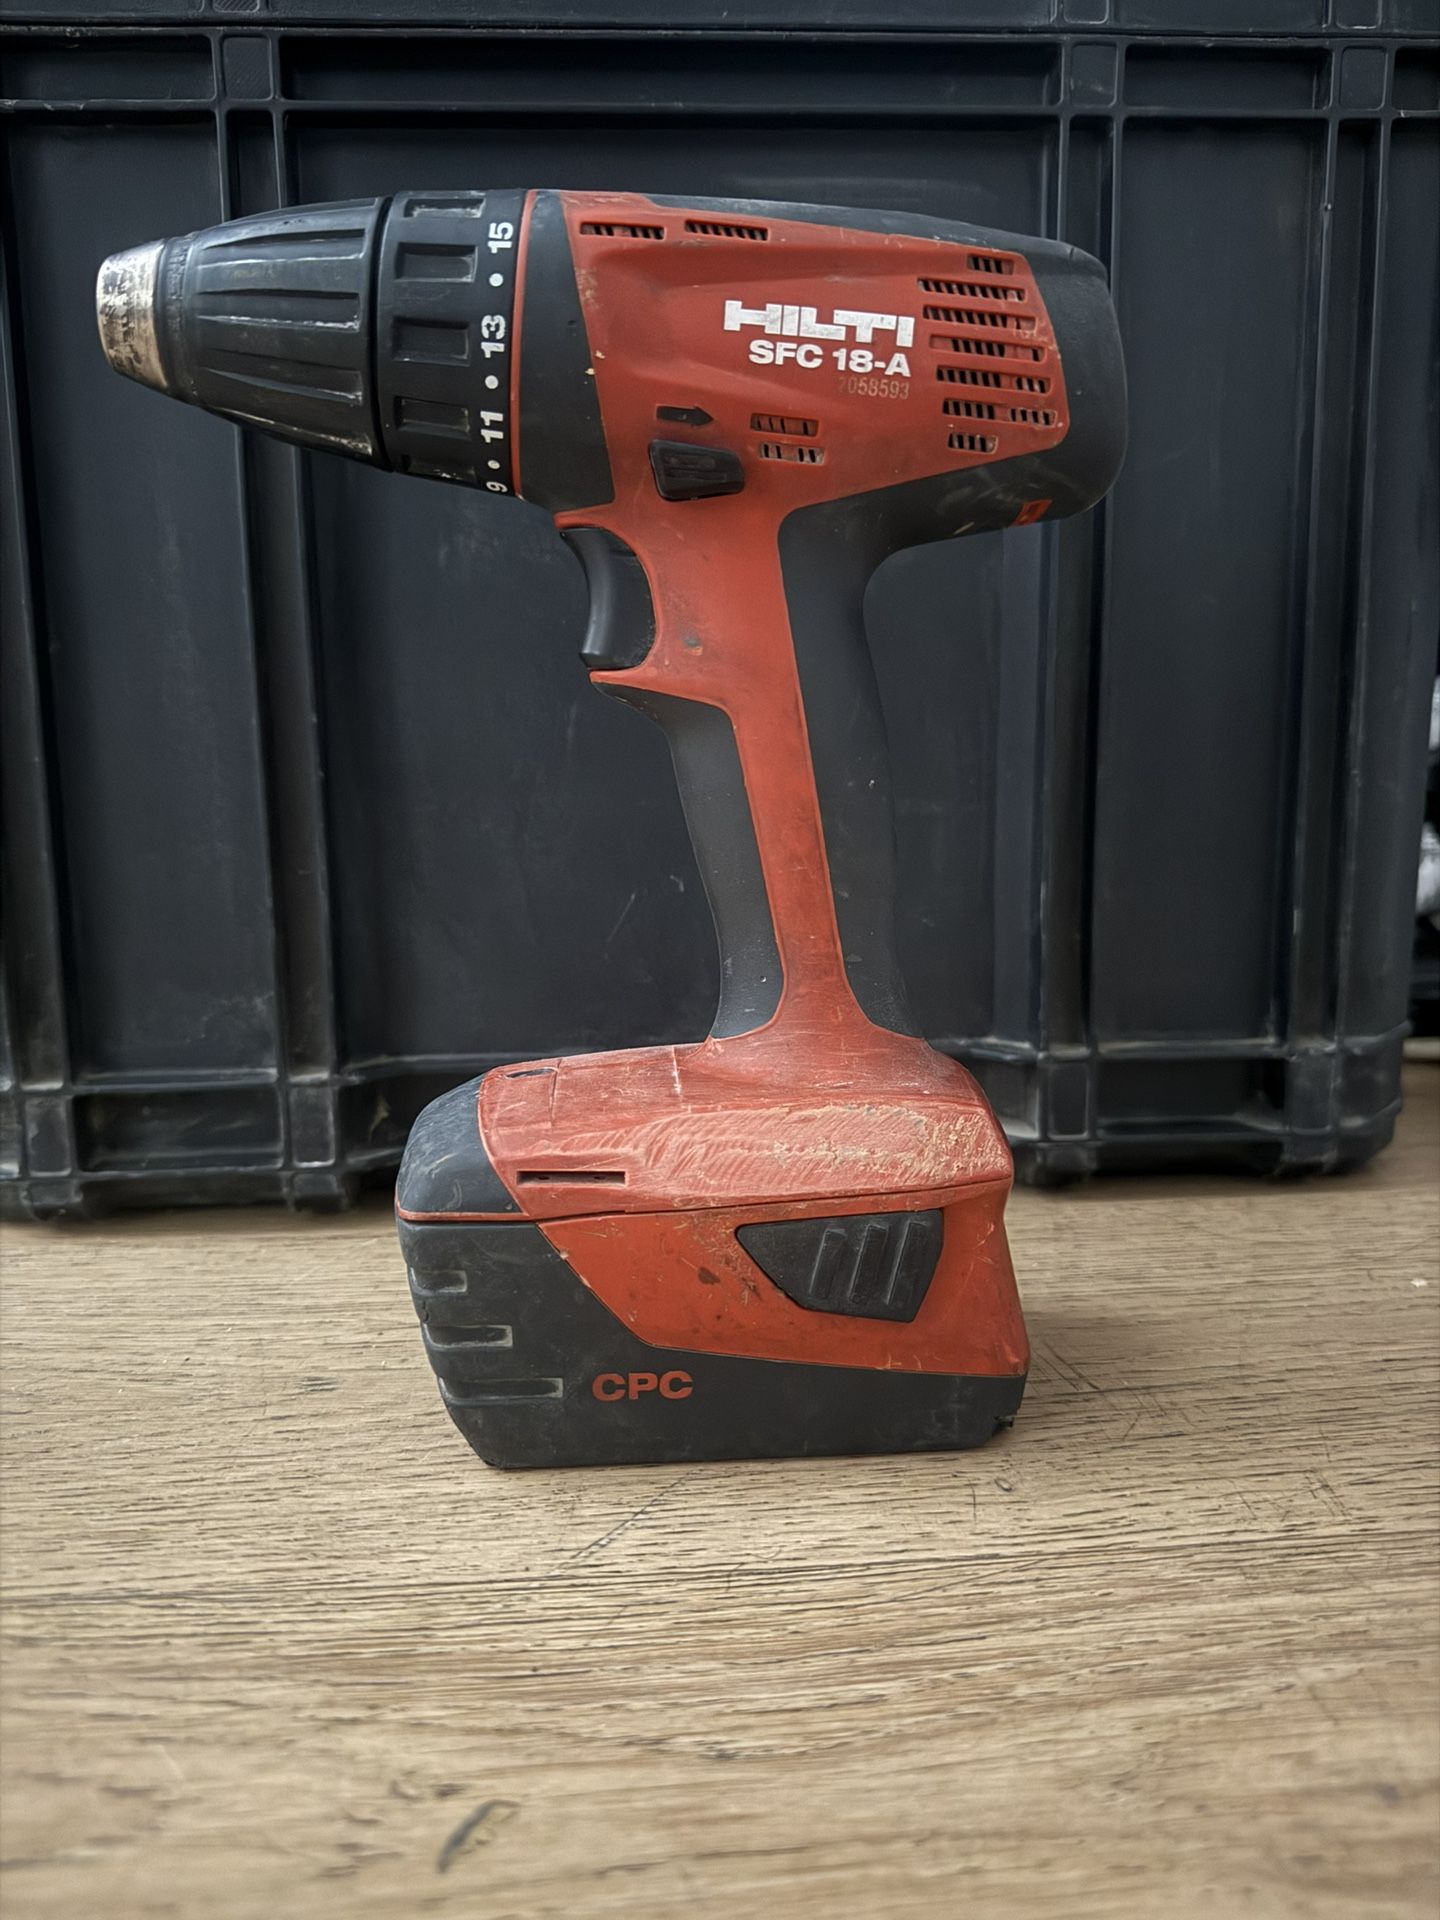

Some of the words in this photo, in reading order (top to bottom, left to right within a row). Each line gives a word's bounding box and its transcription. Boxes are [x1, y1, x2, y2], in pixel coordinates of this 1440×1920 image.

[487, 221, 514, 254] 15
[481, 314, 506, 359] 13
[723, 299, 915, 348] HILTI
[749, 339, 824, 369] SFC
[832, 348, 912, 378] 18-A
[480, 410, 504, 443] 11
[591, 1370, 693, 1401] CPC
